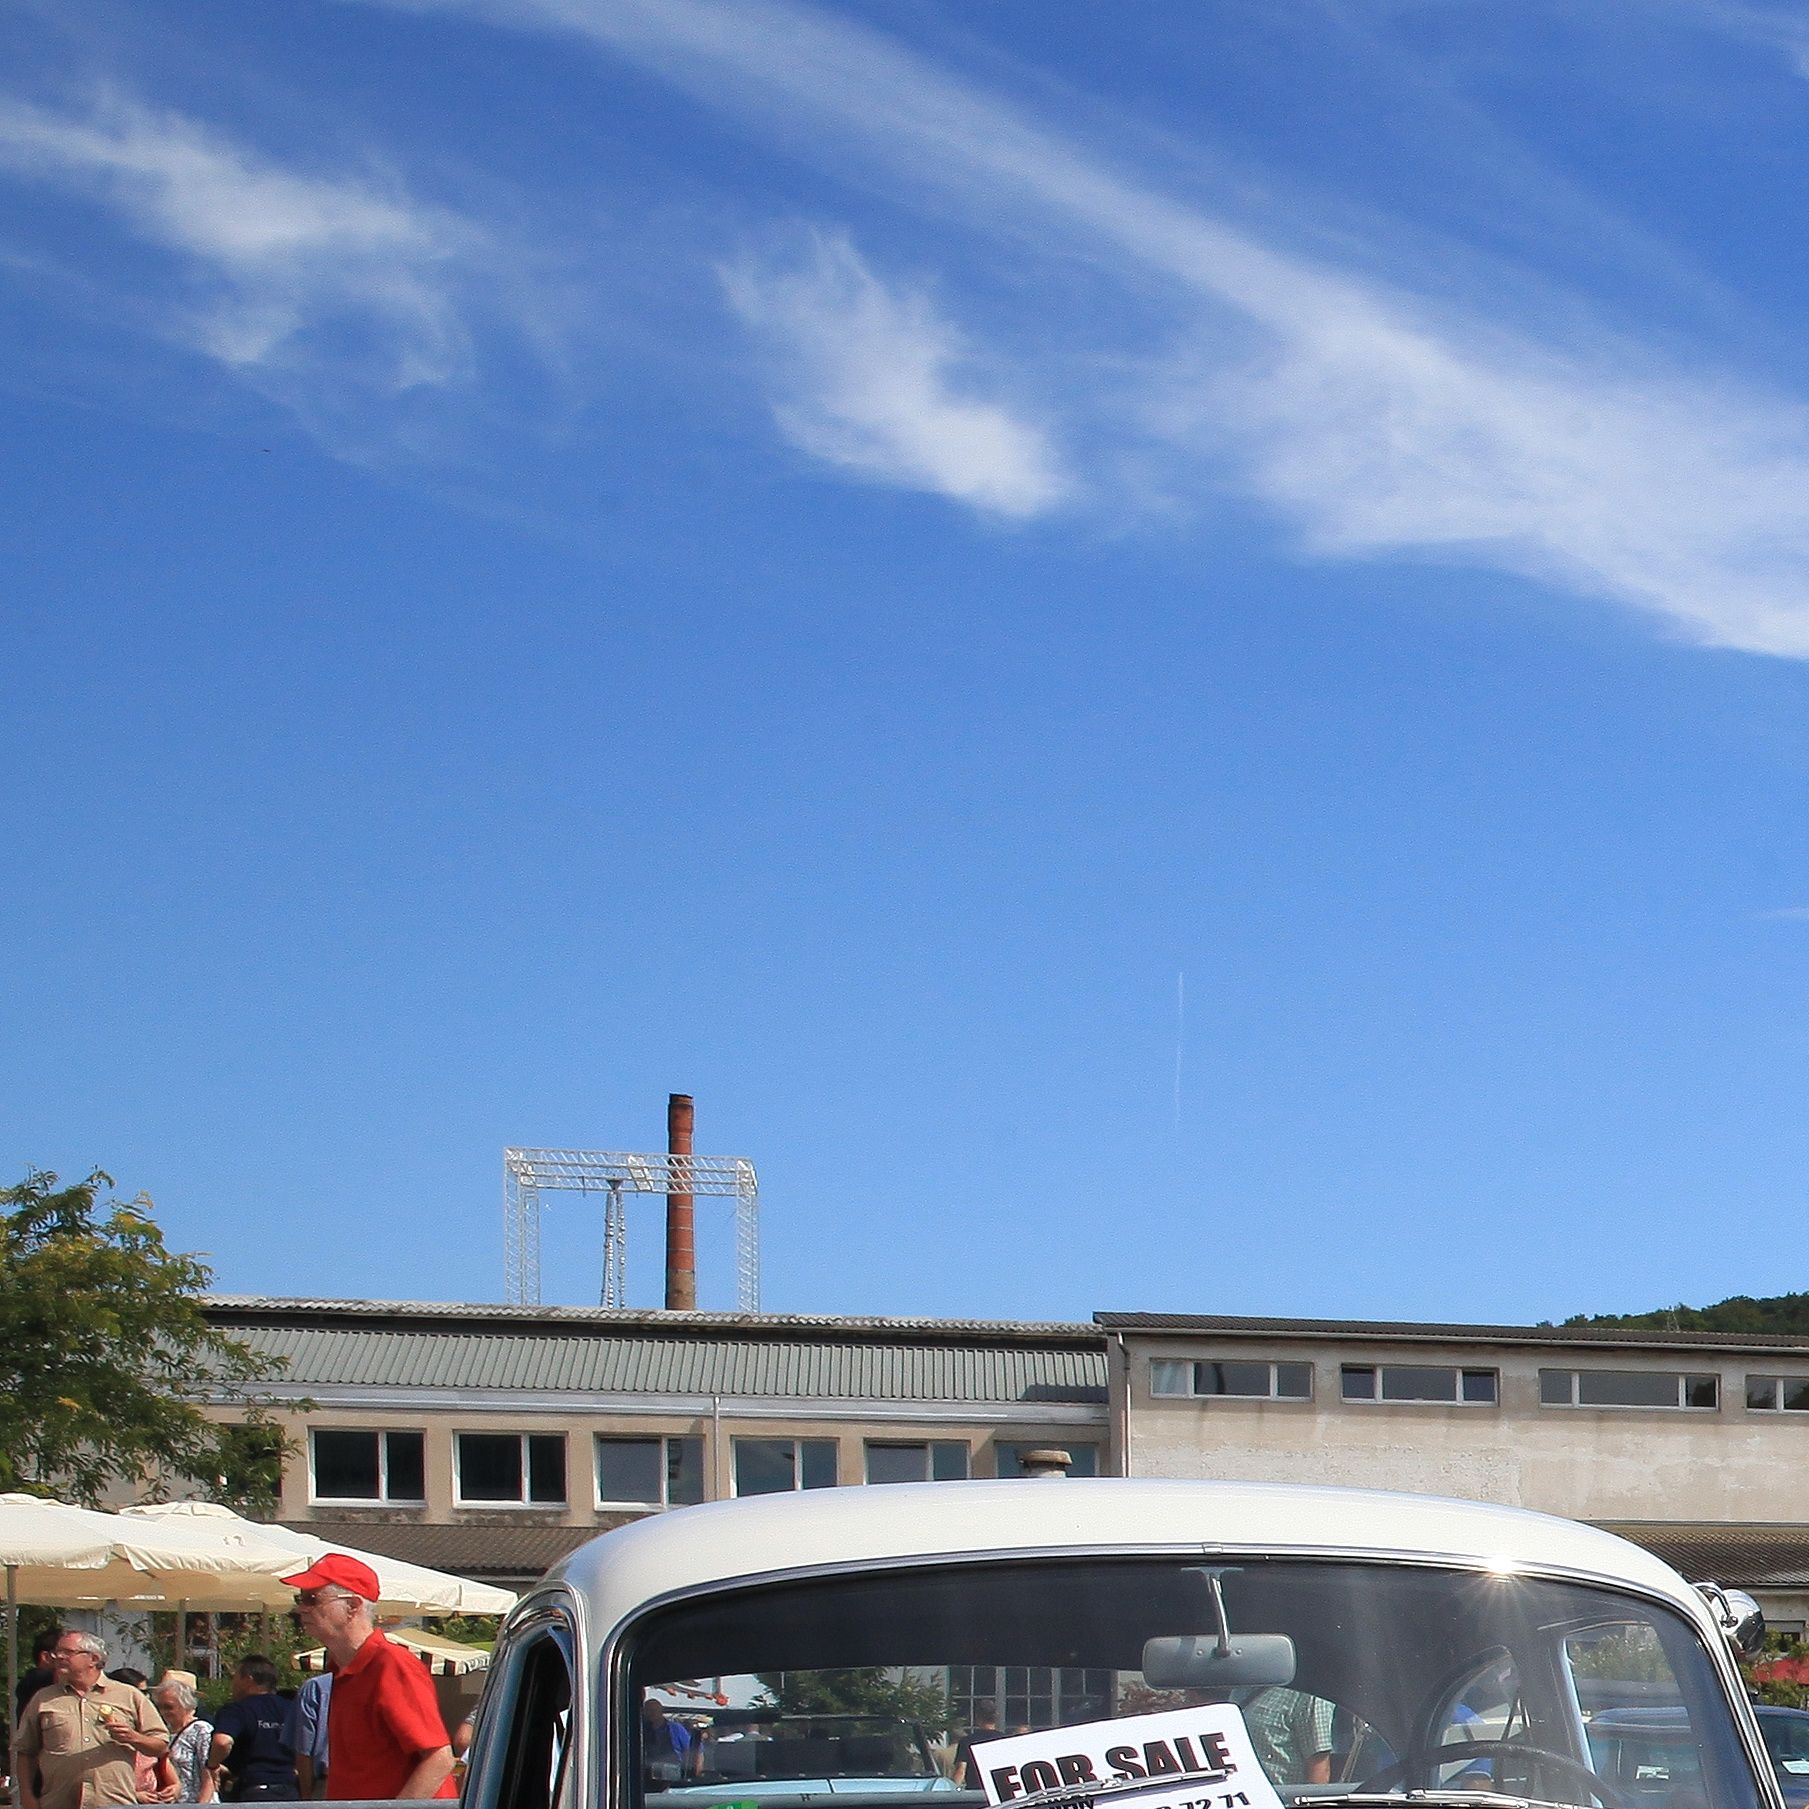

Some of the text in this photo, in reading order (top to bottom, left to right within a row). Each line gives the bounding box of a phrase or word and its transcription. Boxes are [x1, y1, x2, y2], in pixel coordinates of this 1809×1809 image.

[990, 1731, 1238, 1801] FOR SALE
[1217, 1791, 1251, 1809] 71
